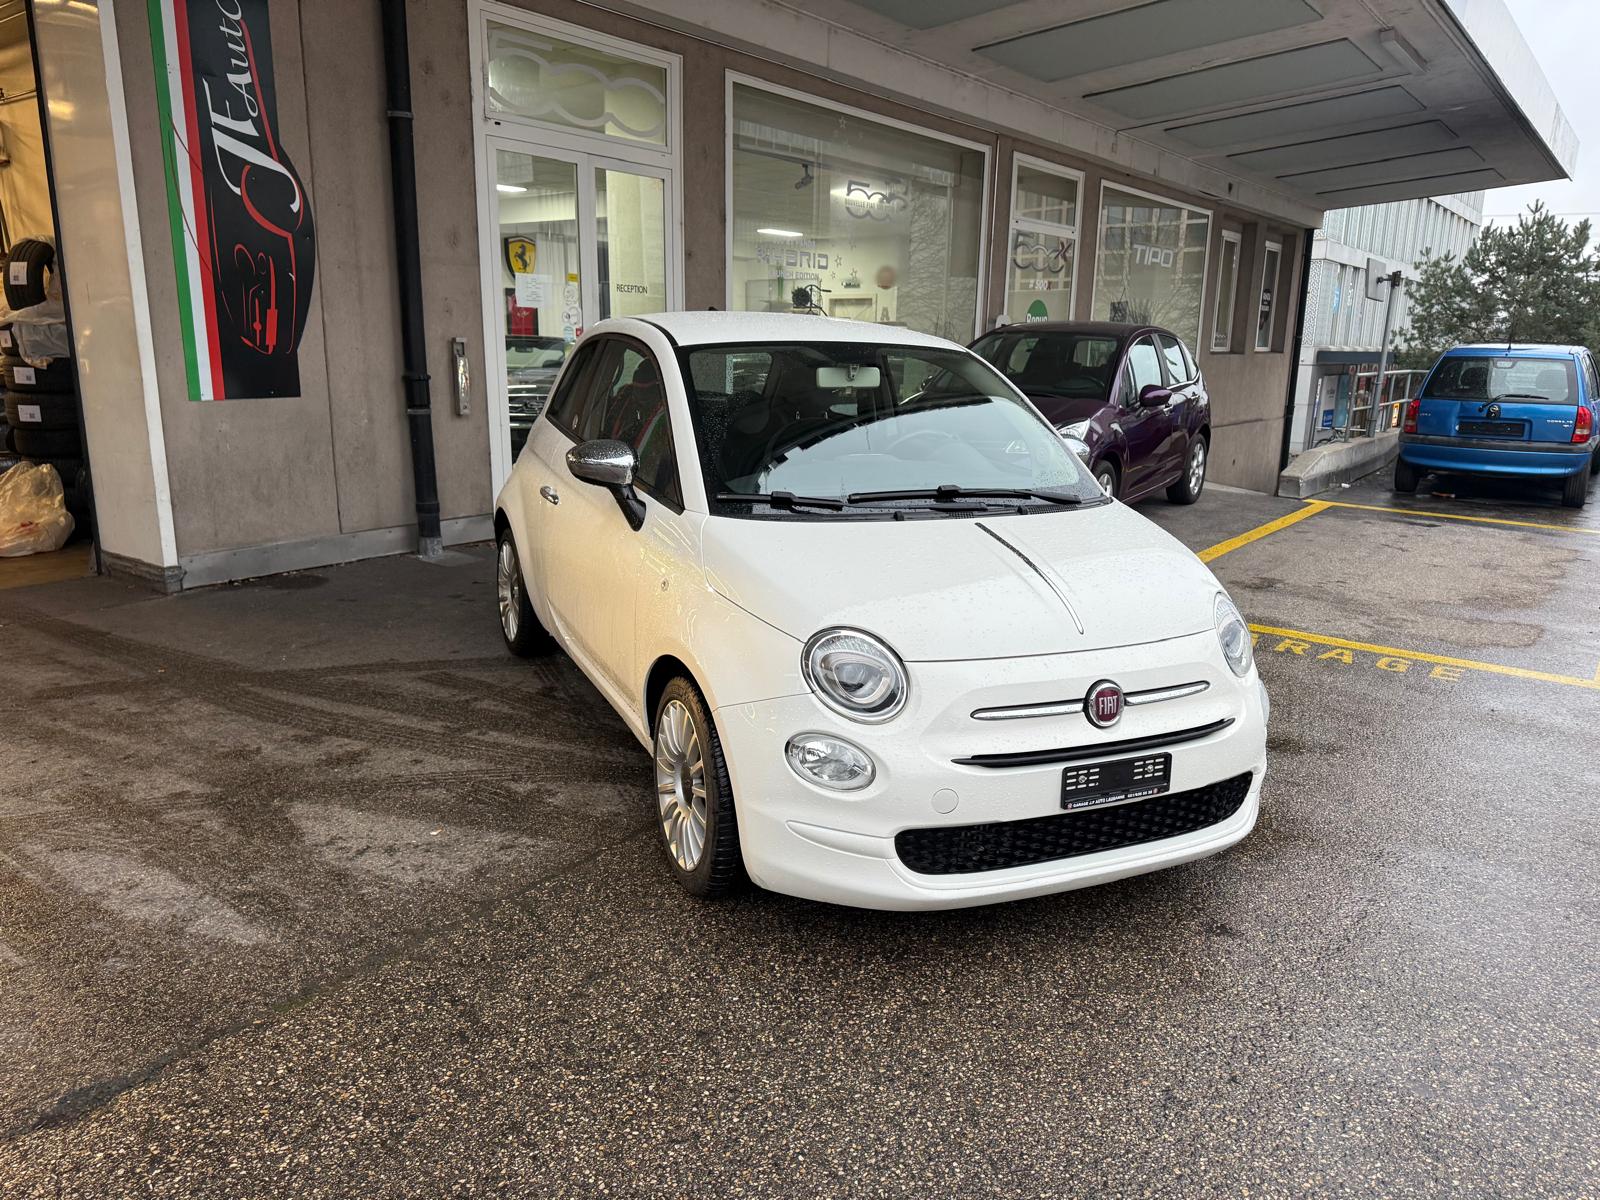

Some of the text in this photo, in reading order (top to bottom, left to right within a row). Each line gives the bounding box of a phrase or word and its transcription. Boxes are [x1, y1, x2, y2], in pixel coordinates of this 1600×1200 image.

[1133, 244, 1173, 268] TIPO
[616, 283, 648, 294] RECEPTION
[1251, 634, 1465, 682] RAGE
[1098, 696, 1118, 715] FIAT
